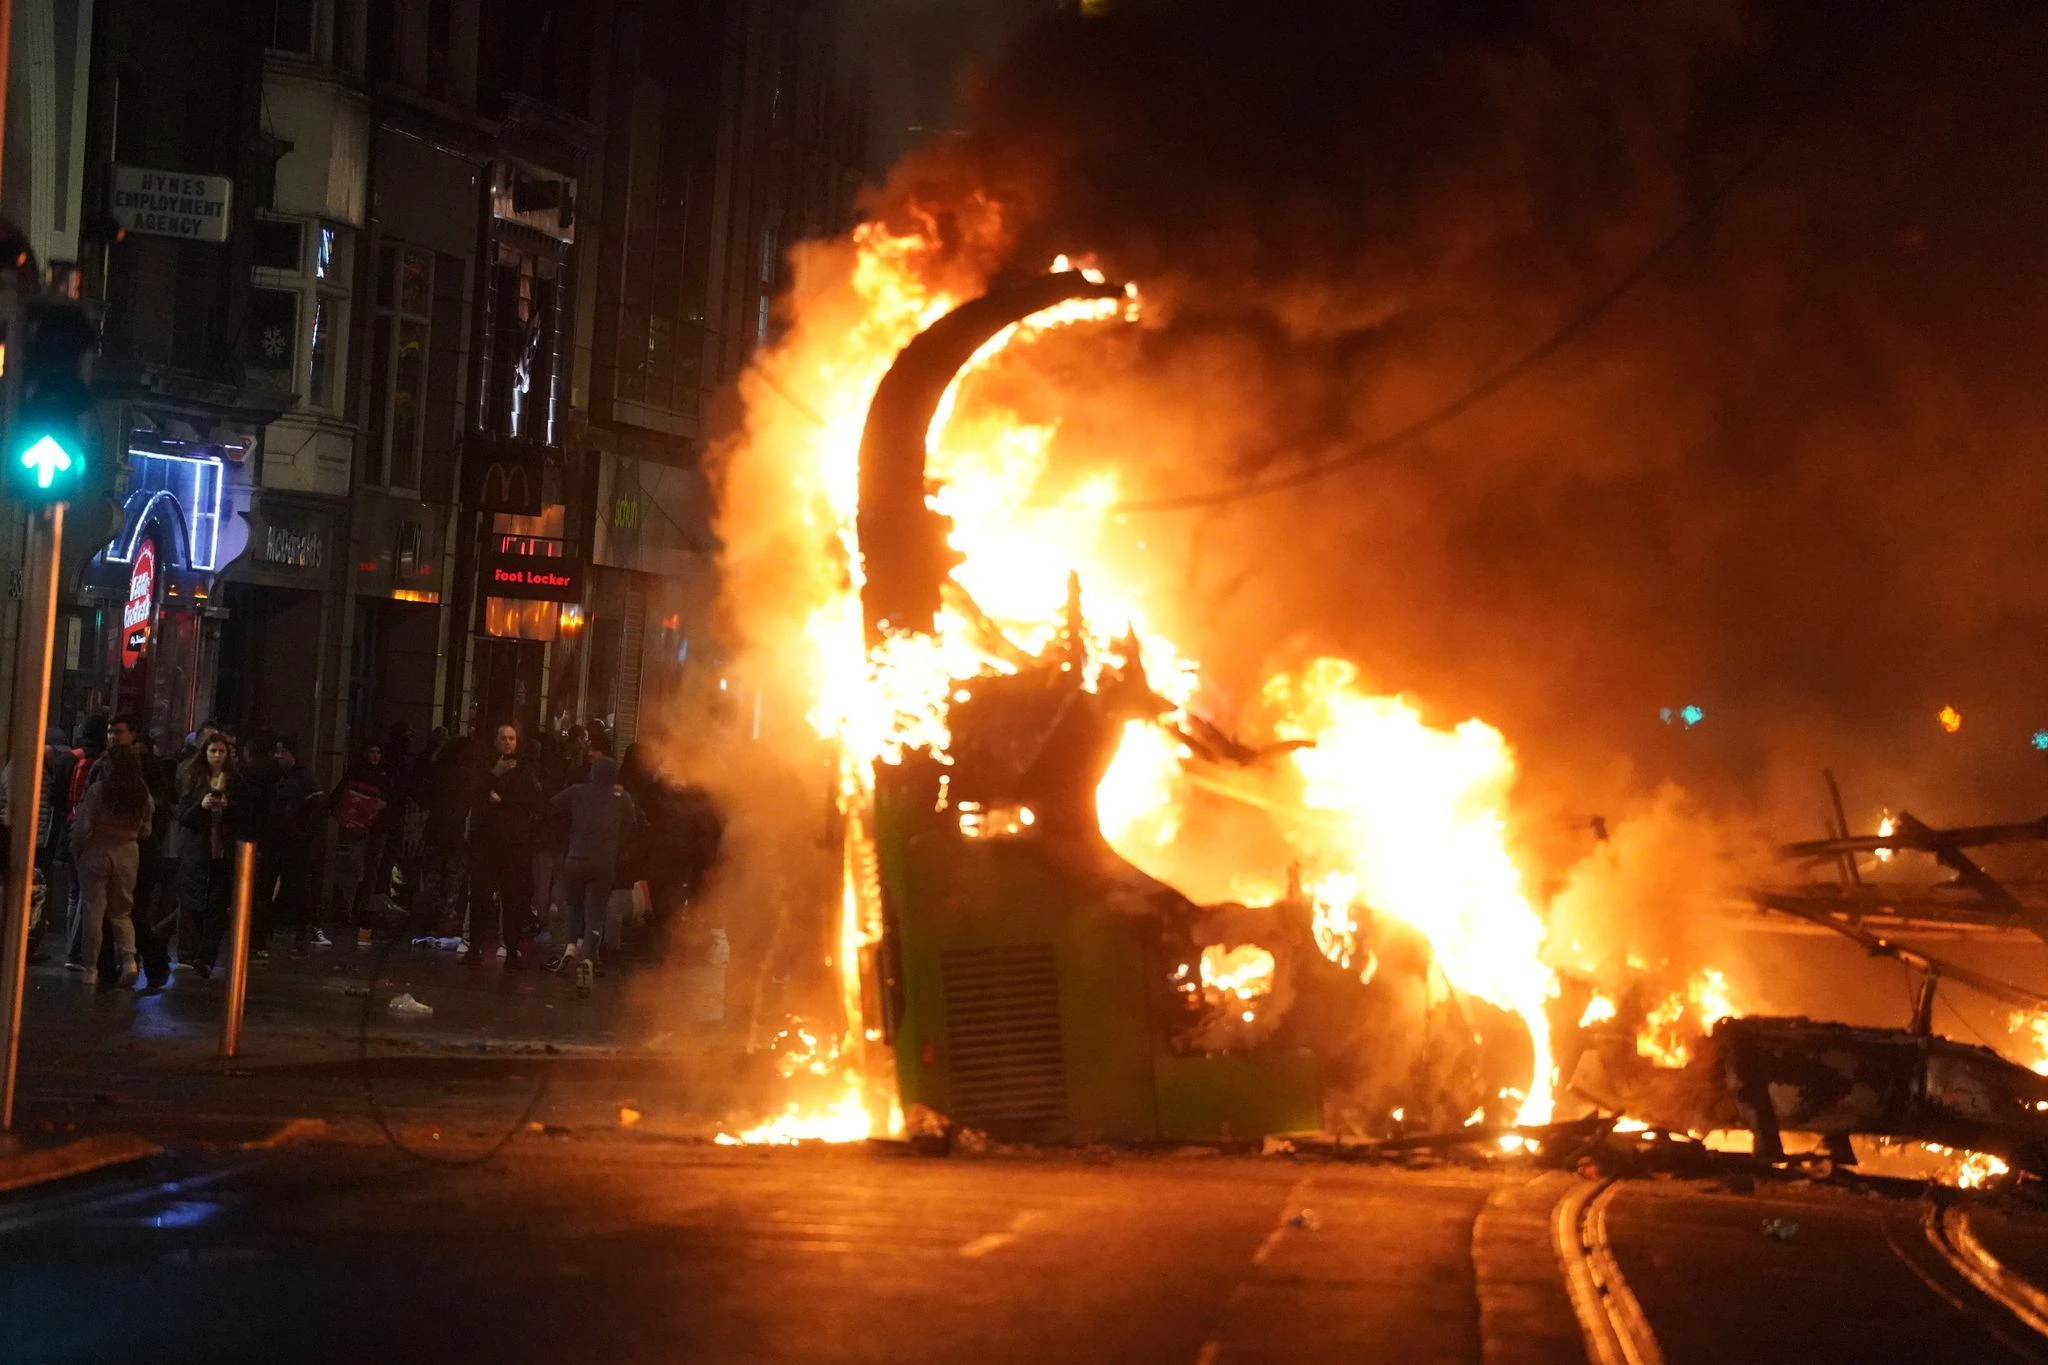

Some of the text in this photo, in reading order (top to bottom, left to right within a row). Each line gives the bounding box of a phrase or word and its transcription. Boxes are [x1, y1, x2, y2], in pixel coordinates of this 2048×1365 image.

[142, 174, 205, 196] HYNES
[115, 190, 225, 217] EMPLOYMENT
[134, 212, 202, 235] AGENCY
[495, 568, 571, 587] Foot Locker
